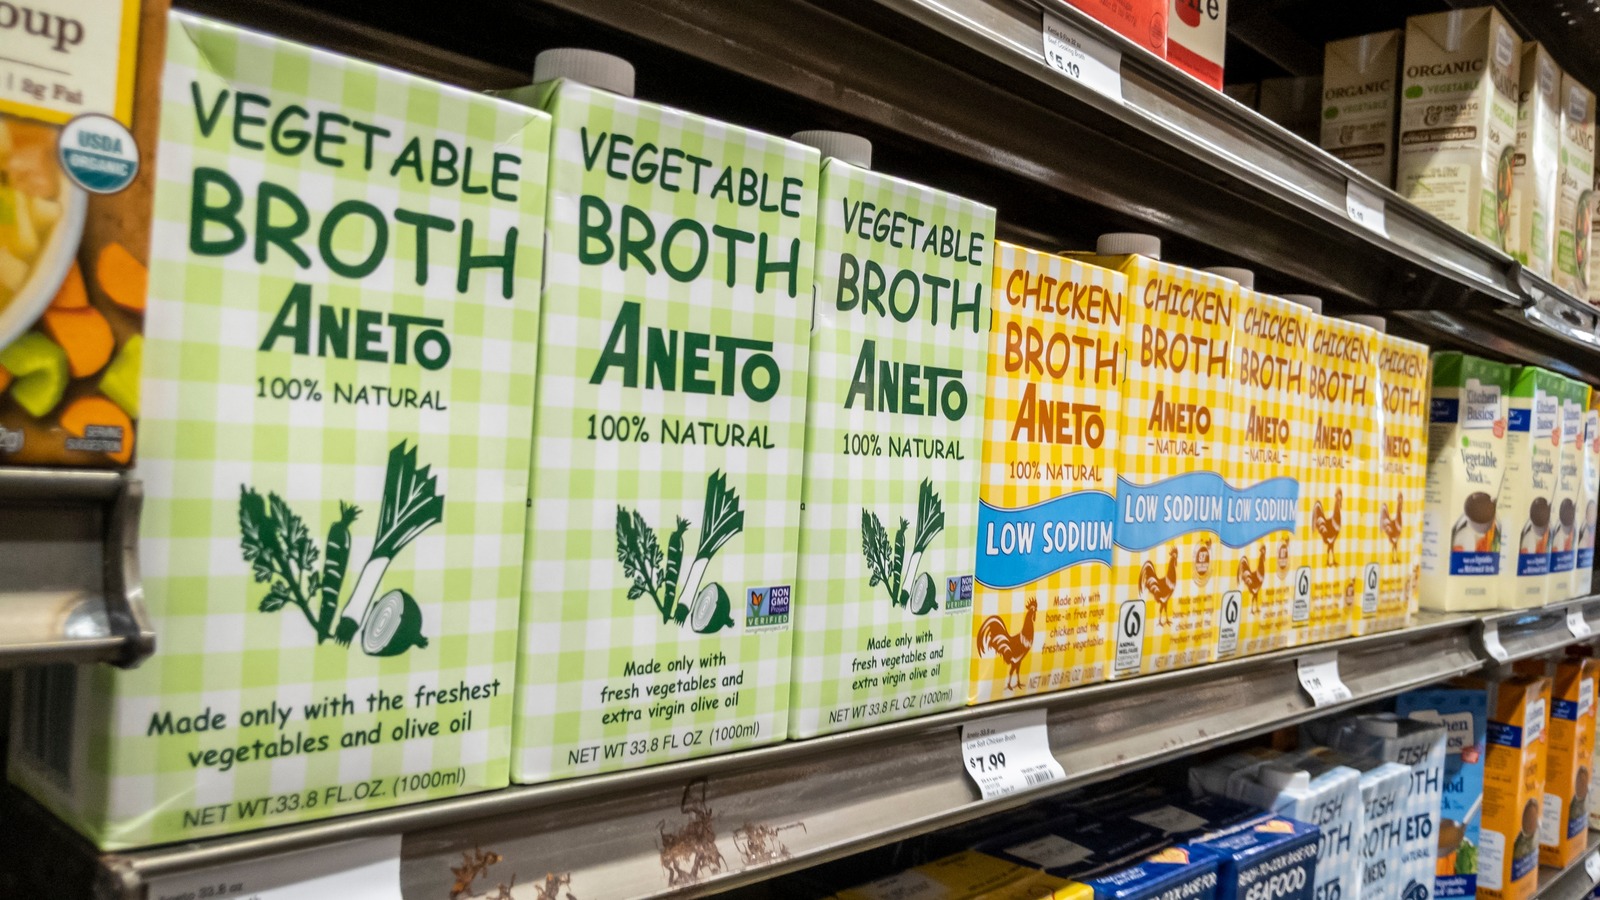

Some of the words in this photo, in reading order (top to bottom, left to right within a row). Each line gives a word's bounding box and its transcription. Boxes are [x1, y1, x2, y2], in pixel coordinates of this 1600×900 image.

[0, 1, 85, 54] oup
[1406, 58, 1484, 78] ORGANIC
[1325, 79, 1391, 100] ORGANIC
[1460, 102, 1478, 111] MSG
[77, 130, 123, 155] USDA
[191, 81, 522, 202] VEGETABLE
[70, 153, 129, 177] ORGANIC
[580, 127, 803, 218] VEGETABLE
[189, 166, 519, 300] BROTH
[578, 195, 801, 298] BROTH
[843, 197, 985, 266] VEGETABLE
[836, 252, 982, 333] BROTH
[1006, 269, 1122, 326] CHICKEN
[1143, 278, 1232, 327] CHICKEN
[258, 283, 452, 371] ANETO
[1243, 307, 1307, 348] CHICKEN
[589, 301, 781, 402] ANETO
[1005, 321, 1119, 386] BROTH
[1140, 324, 1228, 379] BROTH
[1313, 329, 1371, 364] CHICKEN
[1379, 347, 1424, 379] CHICKEN
[844, 339, 968, 421] ANETO
[1240, 347, 1303, 395] BROTH
[1309, 365, 1367, 406] BROTH
[256, 377, 322, 402] 100%
[334, 383, 447, 410] NATURAL
[1382, 382, 1421, 417] ROTH
[1466, 389, 1498, 405] Kitchen
[1010, 382, 1105, 449] ANETO
[1148, 390, 1211, 435] ANETO
[1245, 405, 1289, 444] ANETO
[1467, 407, 1495, 421] Basics
[587, 414, 649, 442] 100%
[661, 419, 775, 449] NATURAL
[843, 433, 882, 456] 100%
[888, 436, 965, 460] NATURAL
[1313, 416, 1352, 451] ANETO
[1010, 461, 1041, 480] 100%
[1046, 463, 1102, 482] NATURAL
[1460, 449, 1498, 470] Vegetable
[1466, 468, 1484, 484] Stock
[1124, 494, 1159, 524] LOW
[1163, 494, 1223, 524] SODIUM
[1226, 497, 1251, 524] LOW
[1255, 498, 1297, 522] SODIUM
[986, 521, 1036, 556] LOW
[1042, 520, 1113, 553] SODIUM
[771, 588, 789, 598] NON
[961, 577, 972, 585] NON
[770, 597, 789, 606] GMO
[1045, 609, 1071, 623] bone-in
[1073, 608, 1087, 619] free
[1089, 608, 1104, 620] range
[1053, 594, 1071, 606] Made
[1073, 593, 1087, 606] only
[1088, 592, 1101, 602] with
[748, 615, 788, 626] VERIFIED
[1049, 625, 1075, 638] chicken
[1076, 625, 1088, 634] and
[1090, 622, 1100, 632] the
[866, 638, 892, 651] Made
[895, 633, 912, 649] only
[916, 630, 933, 644] with
[1041, 642, 1070, 655] freshest
[1072, 638, 1104, 651] vegetables
[624, 658, 661, 677] Made
[667, 655, 694, 674] only
[700, 652, 727, 669] with
[852, 658, 877, 672] fresh
[881, 649, 926, 670] vegetables
[929, 646, 945, 659] and
[600, 683, 640, 703] fresh
[646, 674, 716, 699] vegetables
[722, 670, 744, 687] and
[852, 676, 878, 690] extra
[882, 671, 906, 688] virgin
[909, 668, 928, 681] olive
[930, 664, 941, 677] oil
[147, 707, 227, 736] Made
[240, 700, 292, 729] only
[304, 695, 354, 720] with
[366, 689, 404, 711] the
[414, 678, 501, 708] freshest
[602, 705, 642, 725] extra
[649, 699, 685, 721] virgin
[691, 696, 719, 712] olive
[725, 691, 739, 707] oil
[829, 708, 850, 725] NET
[852, 705, 868, 720] WT
[868, 702, 888, 717] 33.8
[889, 699, 900, 712] FL
[902, 695, 917, 709] OZ
[919, 688, 953, 708] (1000ml)
[188, 733, 329, 772] vegetables
[341, 722, 381, 748] and
[392, 717, 439, 742] olive
[450, 710, 473, 734] oil
[568, 746, 600, 766] NET
[604, 741, 628, 759] WT
[630, 738, 659, 756] 33.8
[662, 734, 679, 750] FL
[683, 730, 703, 746] OZ
[709, 721, 760, 745] (1000ml)
[966, 742, 976, 751] Low
[986, 737, 1004, 746] Chicken
[1004, 733, 1017, 742] Broth
[1397, 742, 1432, 766] FISH
[969, 752, 1006, 773] $7.99
[183, 804, 232, 828] NET
[393, 767, 466, 797] (1000ml)
[1312, 793, 1345, 826] FISH
[1245, 865, 1307, 900] SEAFOOD
